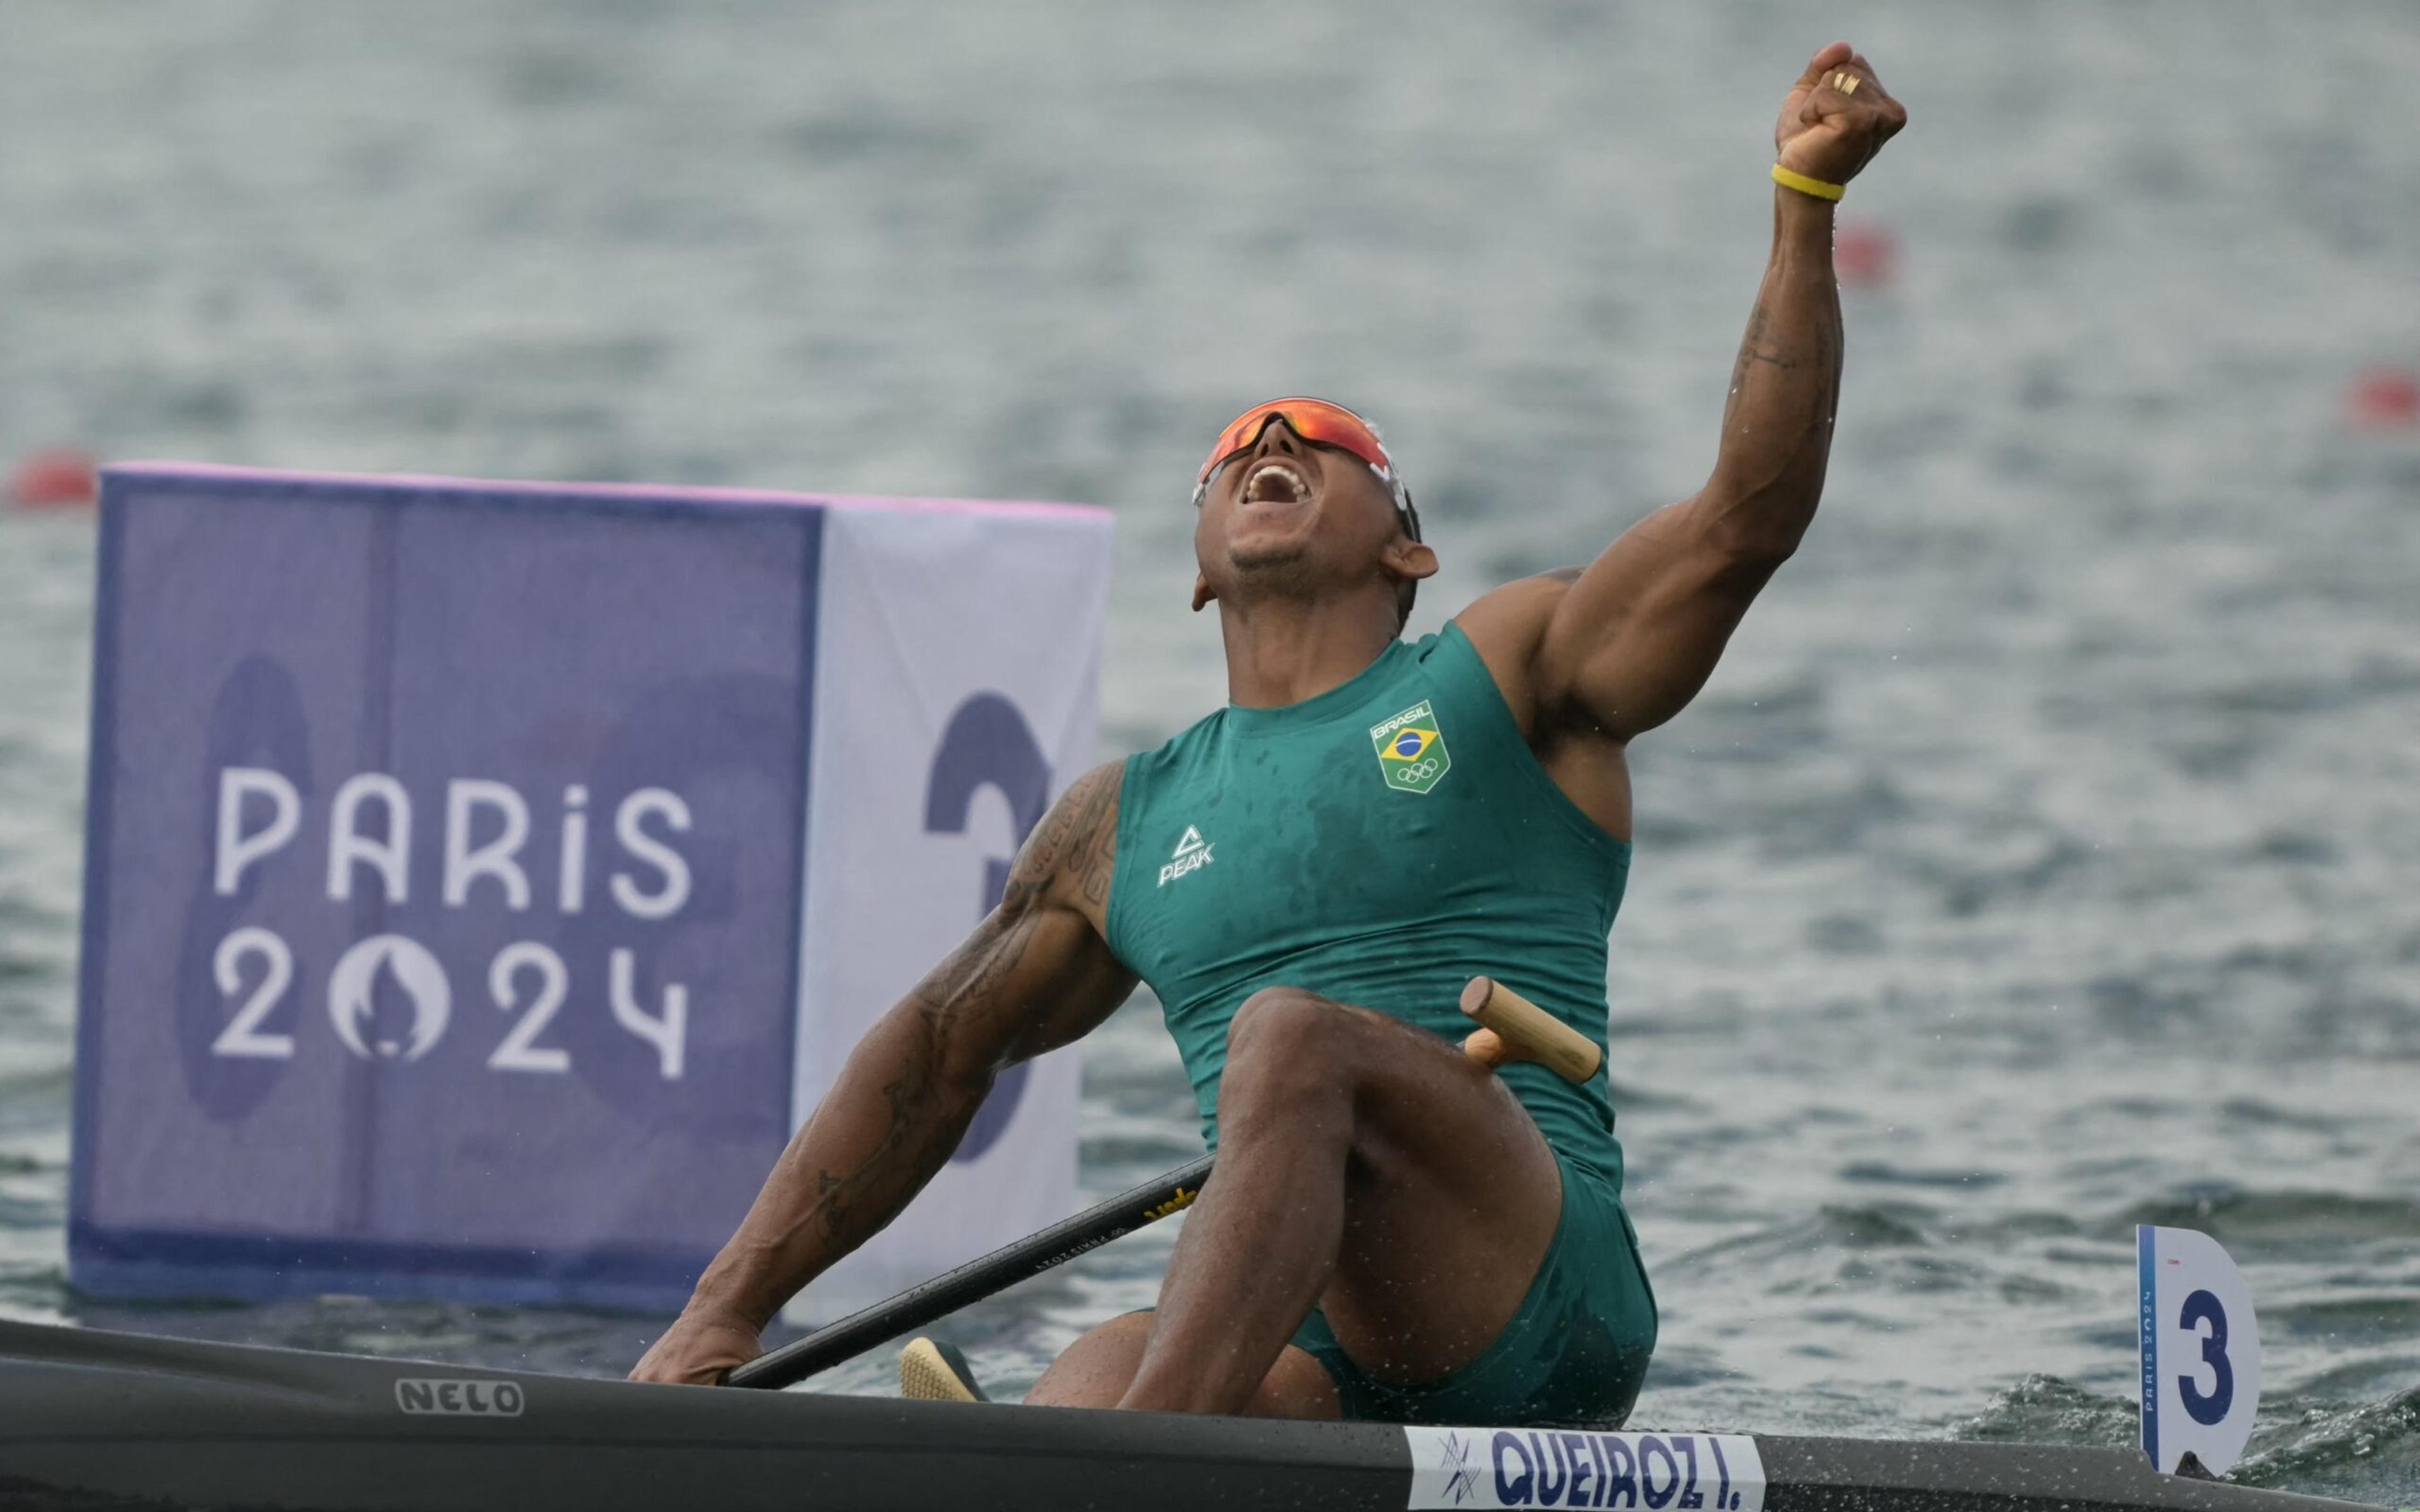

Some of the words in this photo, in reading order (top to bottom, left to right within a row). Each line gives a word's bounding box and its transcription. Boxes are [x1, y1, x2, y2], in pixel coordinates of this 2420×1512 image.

[1373, 706, 1431, 740] BRASIL
[1157, 842, 1216, 888] PEAK
[212, 926, 689, 1079] 2024
[2143, 1292, 2153, 1344] 2024
[2145, 1353, 2153, 1412] PARIS
[2178, 1289, 2233, 1426] 3
[400, 1383, 521, 1413] NELO
[1492, 1431, 1703, 1510] QUEIROZ
[1709, 1436, 1741, 1511] I.
